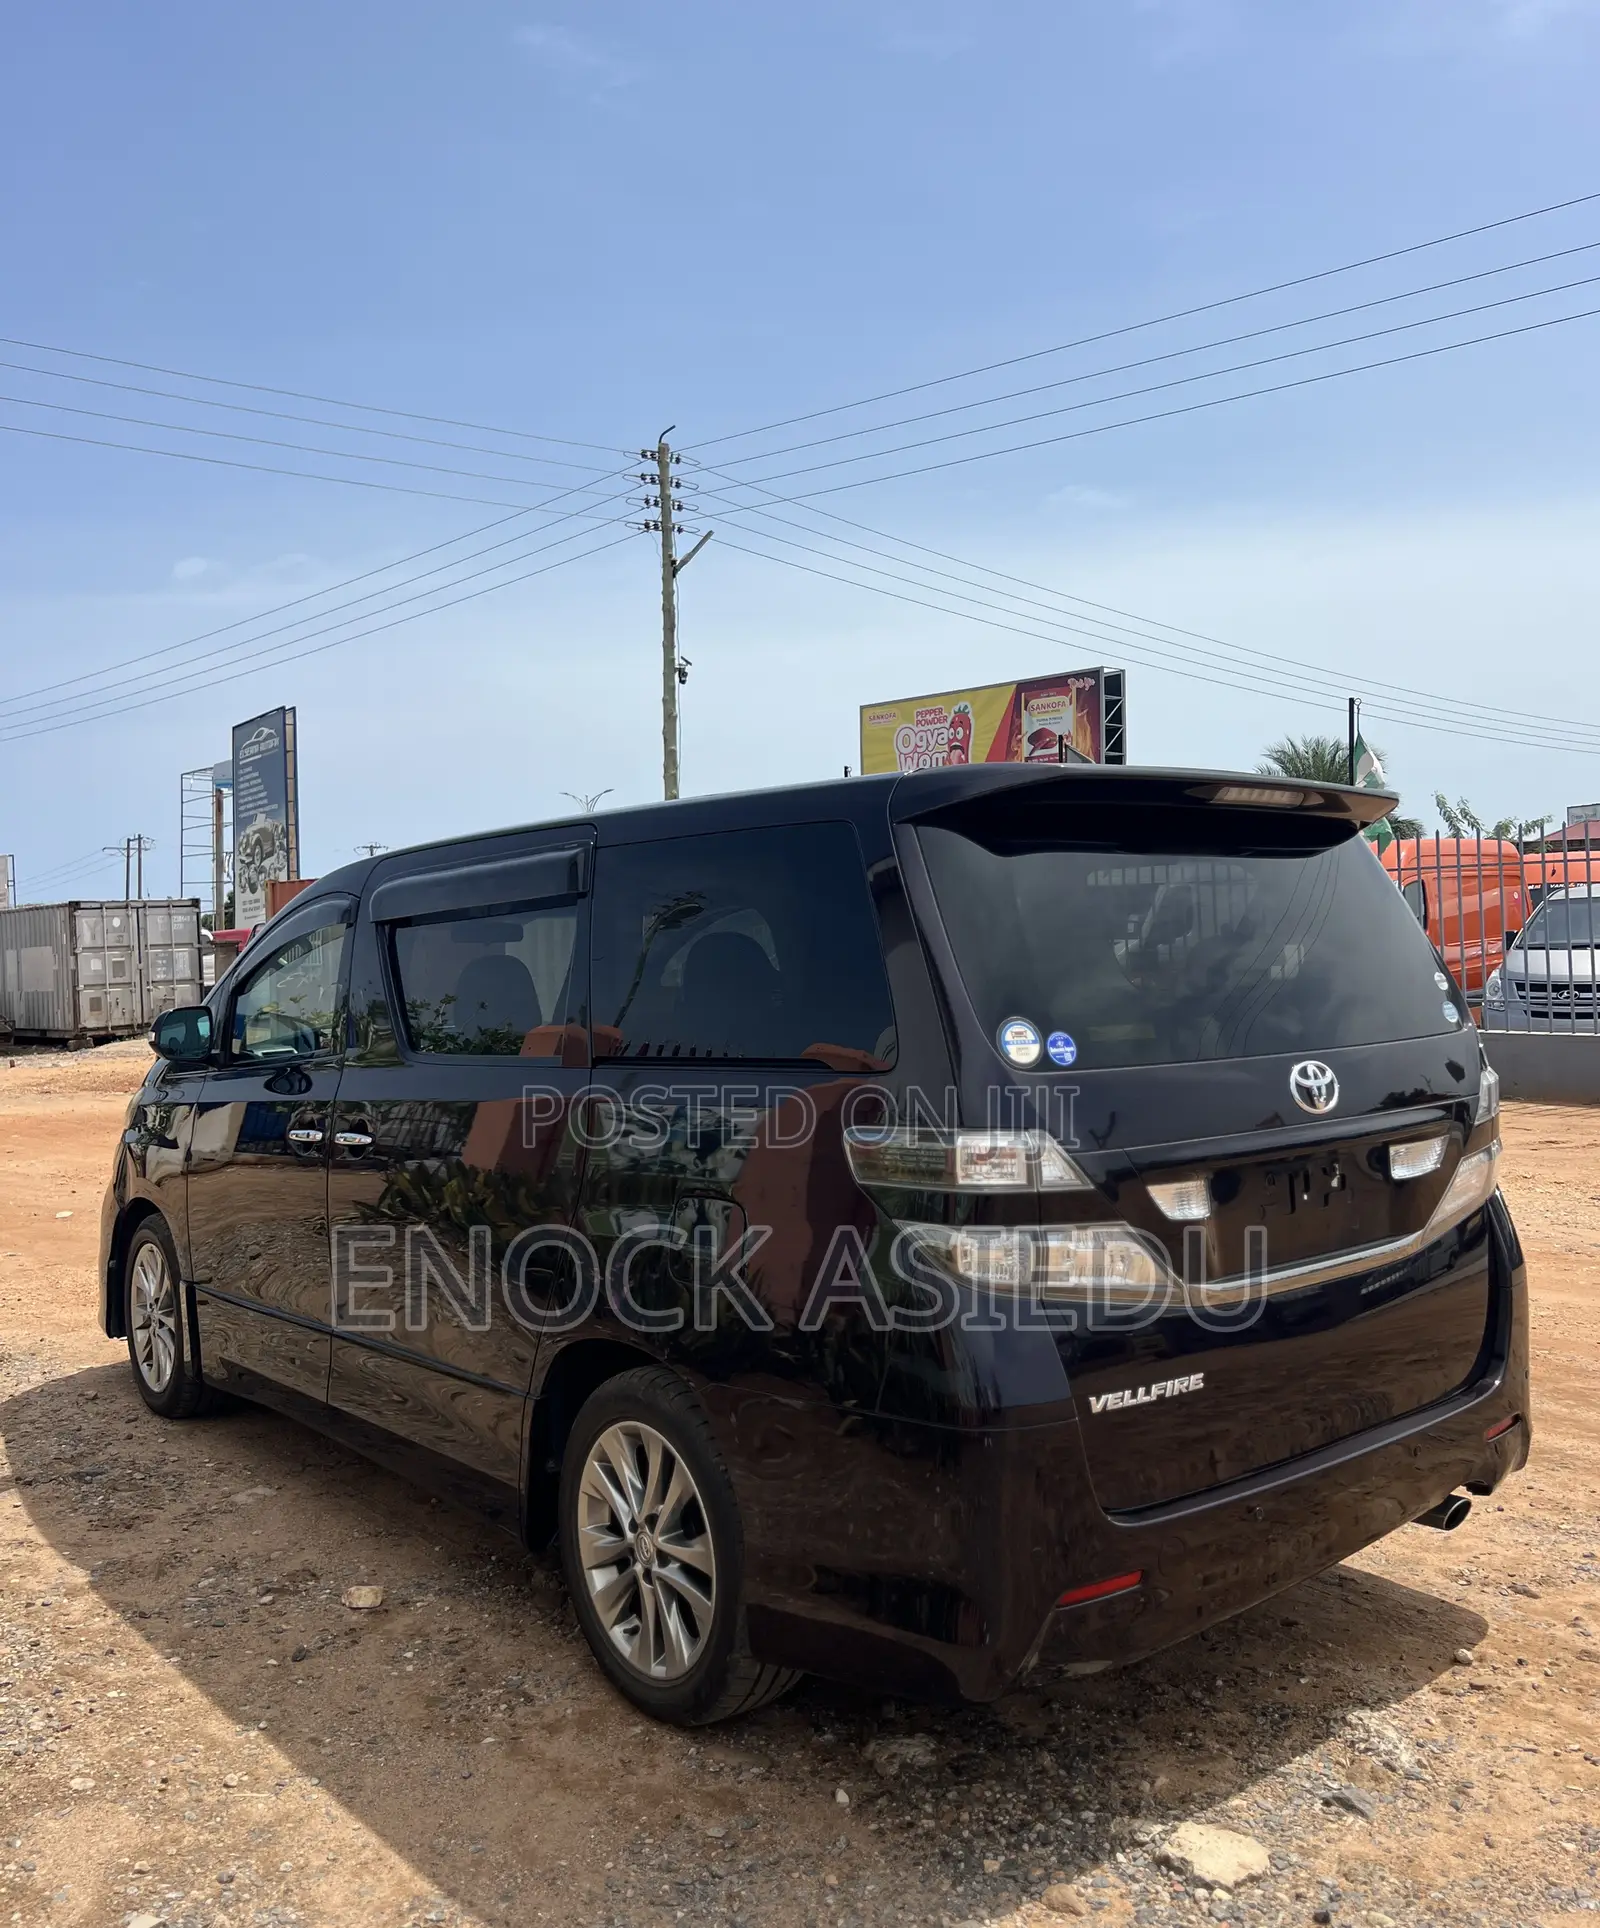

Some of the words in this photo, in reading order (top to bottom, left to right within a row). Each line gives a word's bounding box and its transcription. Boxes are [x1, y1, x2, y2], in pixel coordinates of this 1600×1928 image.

[1030, 700, 1067, 712] SANKOFA
[868, 712, 897, 722] SANKOFA
[915, 707, 943, 719] PEPPER
[915, 715, 948, 727] POWDER
[896, 727, 950, 754] Ogya
[1088, 1372, 1205, 1414] VELLFIRE
